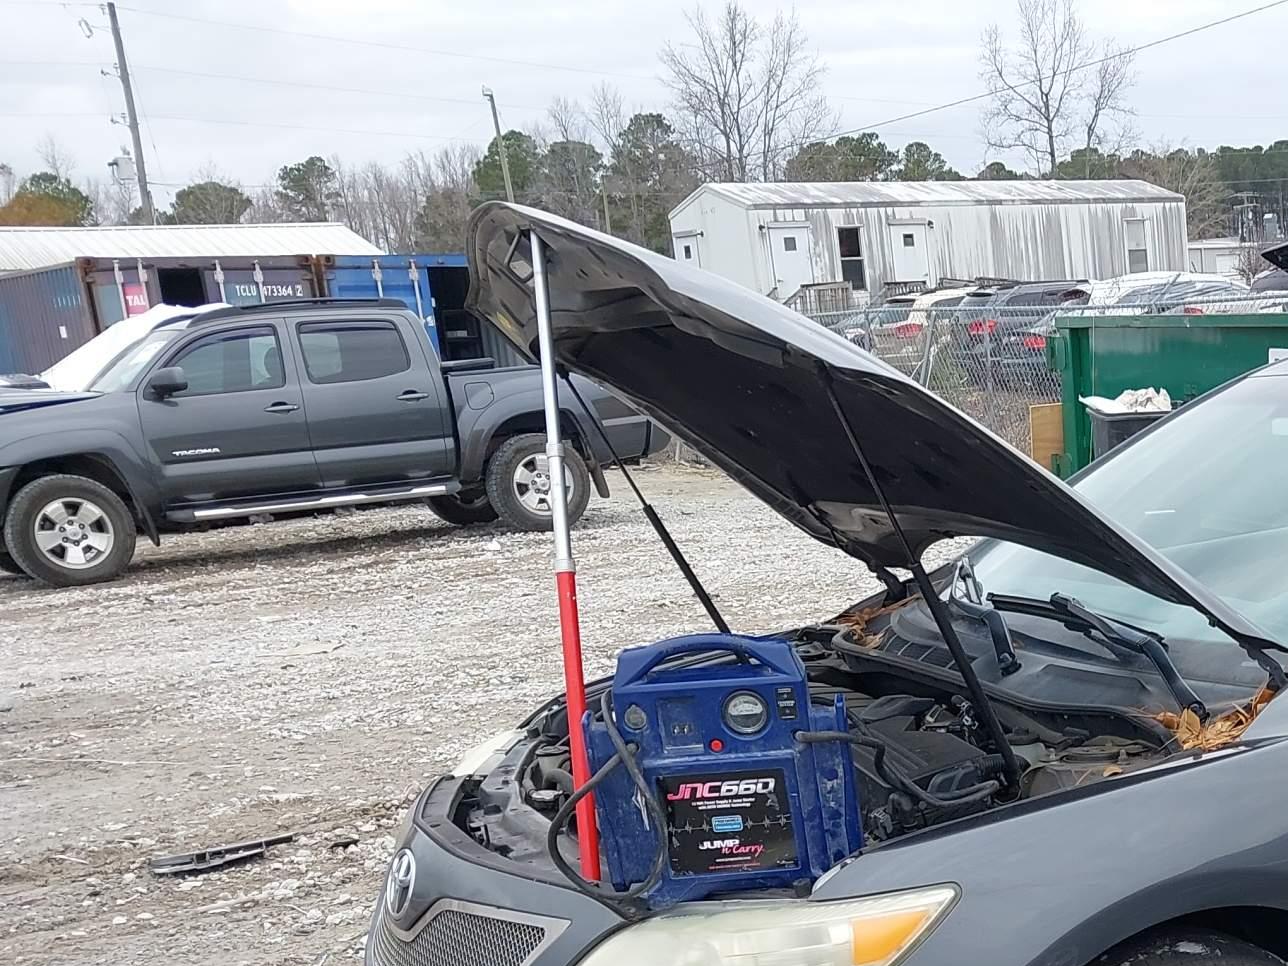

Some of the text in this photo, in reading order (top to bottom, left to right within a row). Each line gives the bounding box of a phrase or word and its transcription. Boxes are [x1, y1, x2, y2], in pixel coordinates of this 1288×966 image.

[235, 284, 257, 297] TCLU
[171, 447, 221, 457] TACOMA
[698, 838, 740, 851] JUMP
[732, 844, 765, 858] Carry
